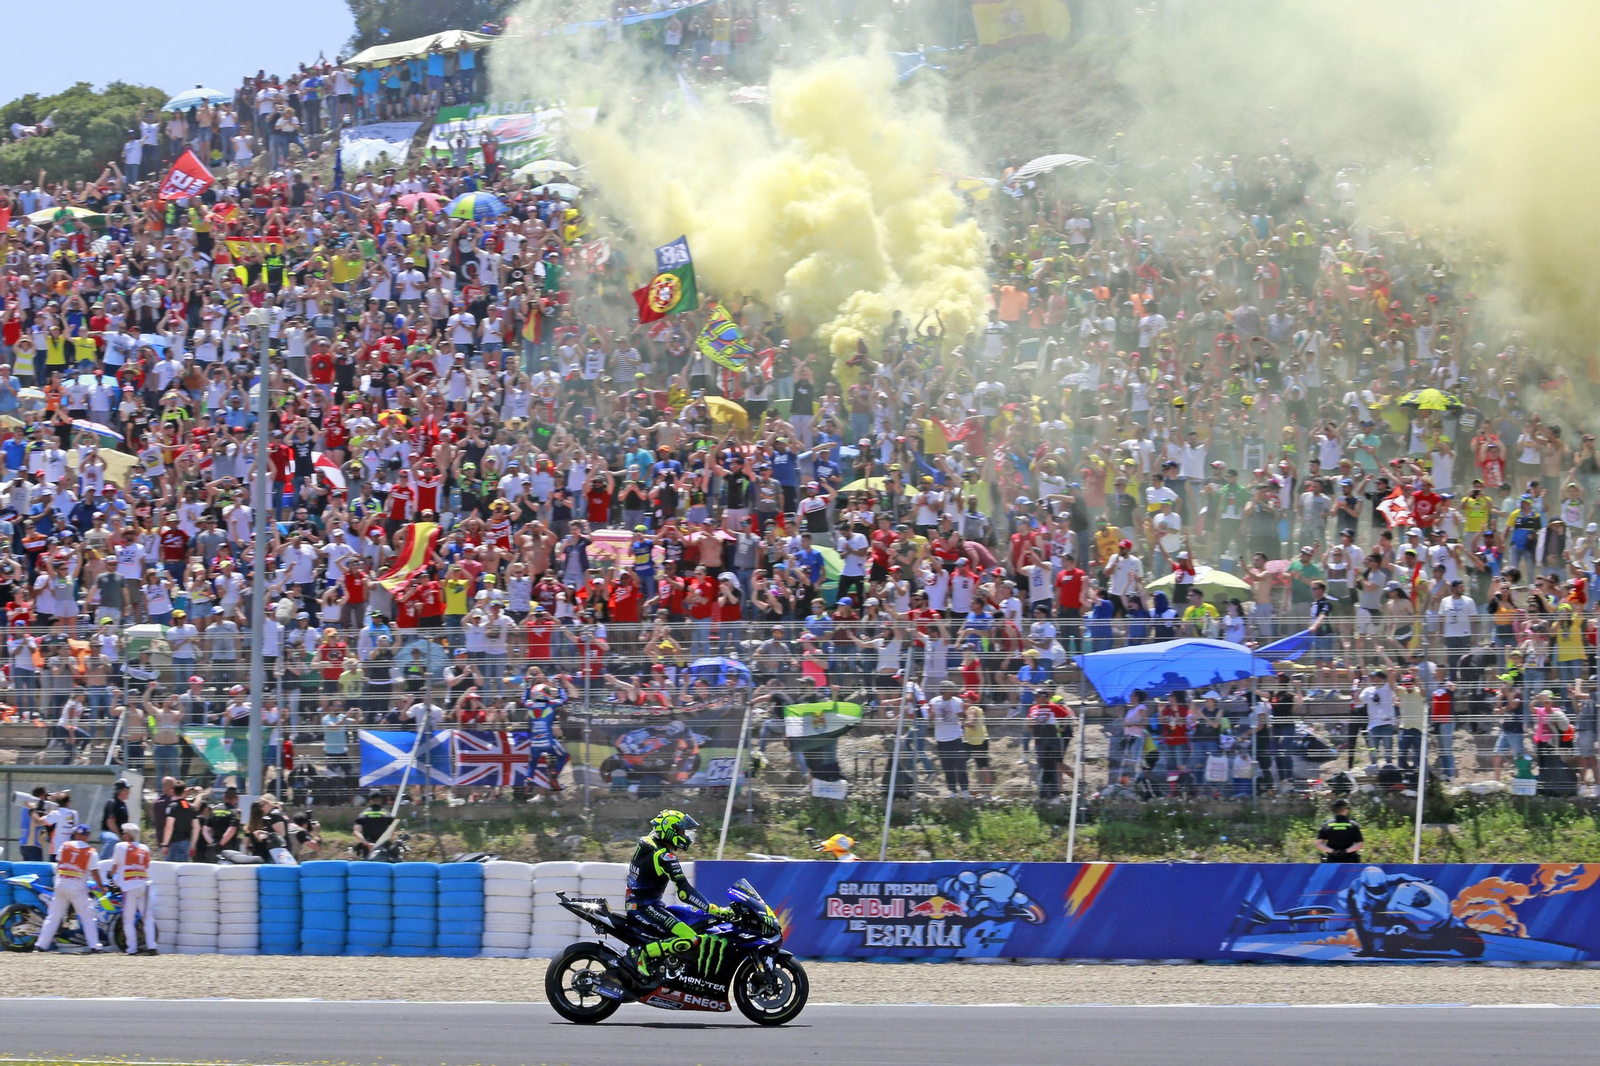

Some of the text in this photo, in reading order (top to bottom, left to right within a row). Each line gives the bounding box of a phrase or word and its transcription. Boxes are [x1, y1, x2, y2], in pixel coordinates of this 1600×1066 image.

[839, 883, 937, 896] GRAN PREMIO
[688, 894, 708, 911] YAMAHA
[827, 898, 904, 919] Red Bull
[850, 920, 866, 930] DE
[865, 920, 963, 947] ESPAÑA
[678, 974, 726, 992] MONSTER
[684, 993, 726, 1011] ENEOS
